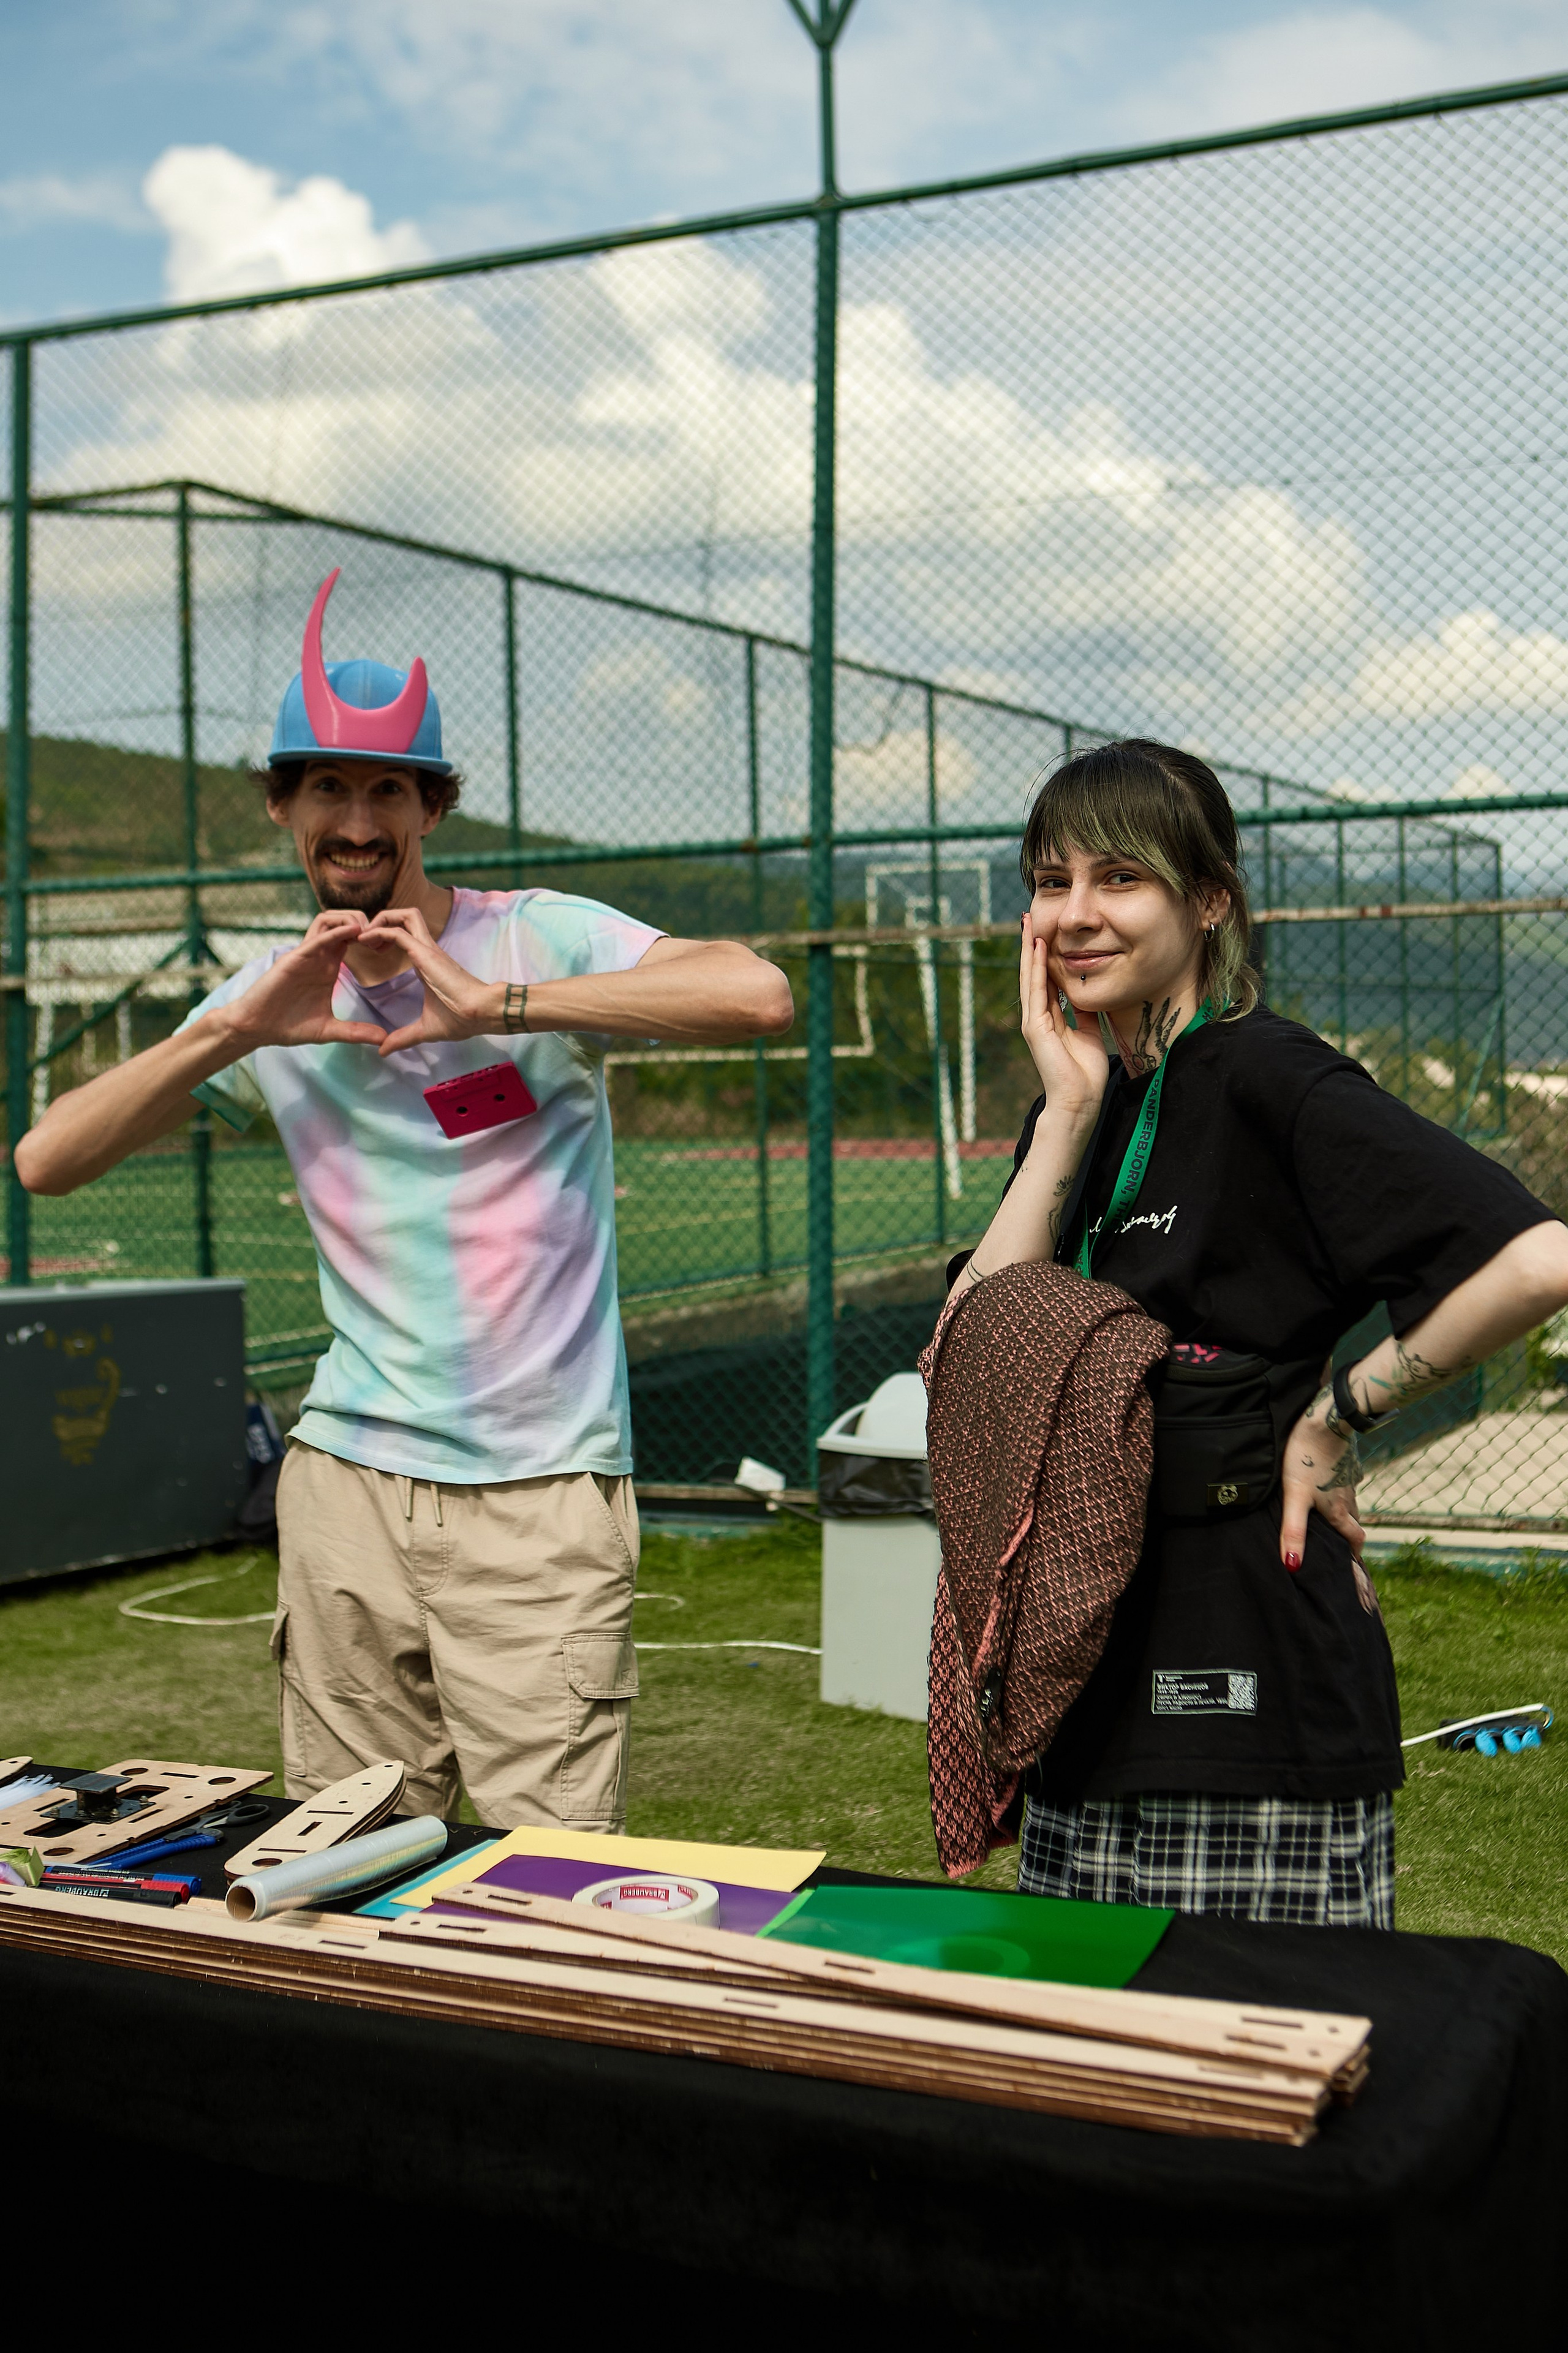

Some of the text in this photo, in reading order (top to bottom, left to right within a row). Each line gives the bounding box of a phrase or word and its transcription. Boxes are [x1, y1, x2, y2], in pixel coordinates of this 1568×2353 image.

[1121, 1079, 1159, 1194] PANDERBJORN,
[55, 1885, 99, 1897] BRAUBERG
[624, 1889, 658, 1898] BRAUBERG
